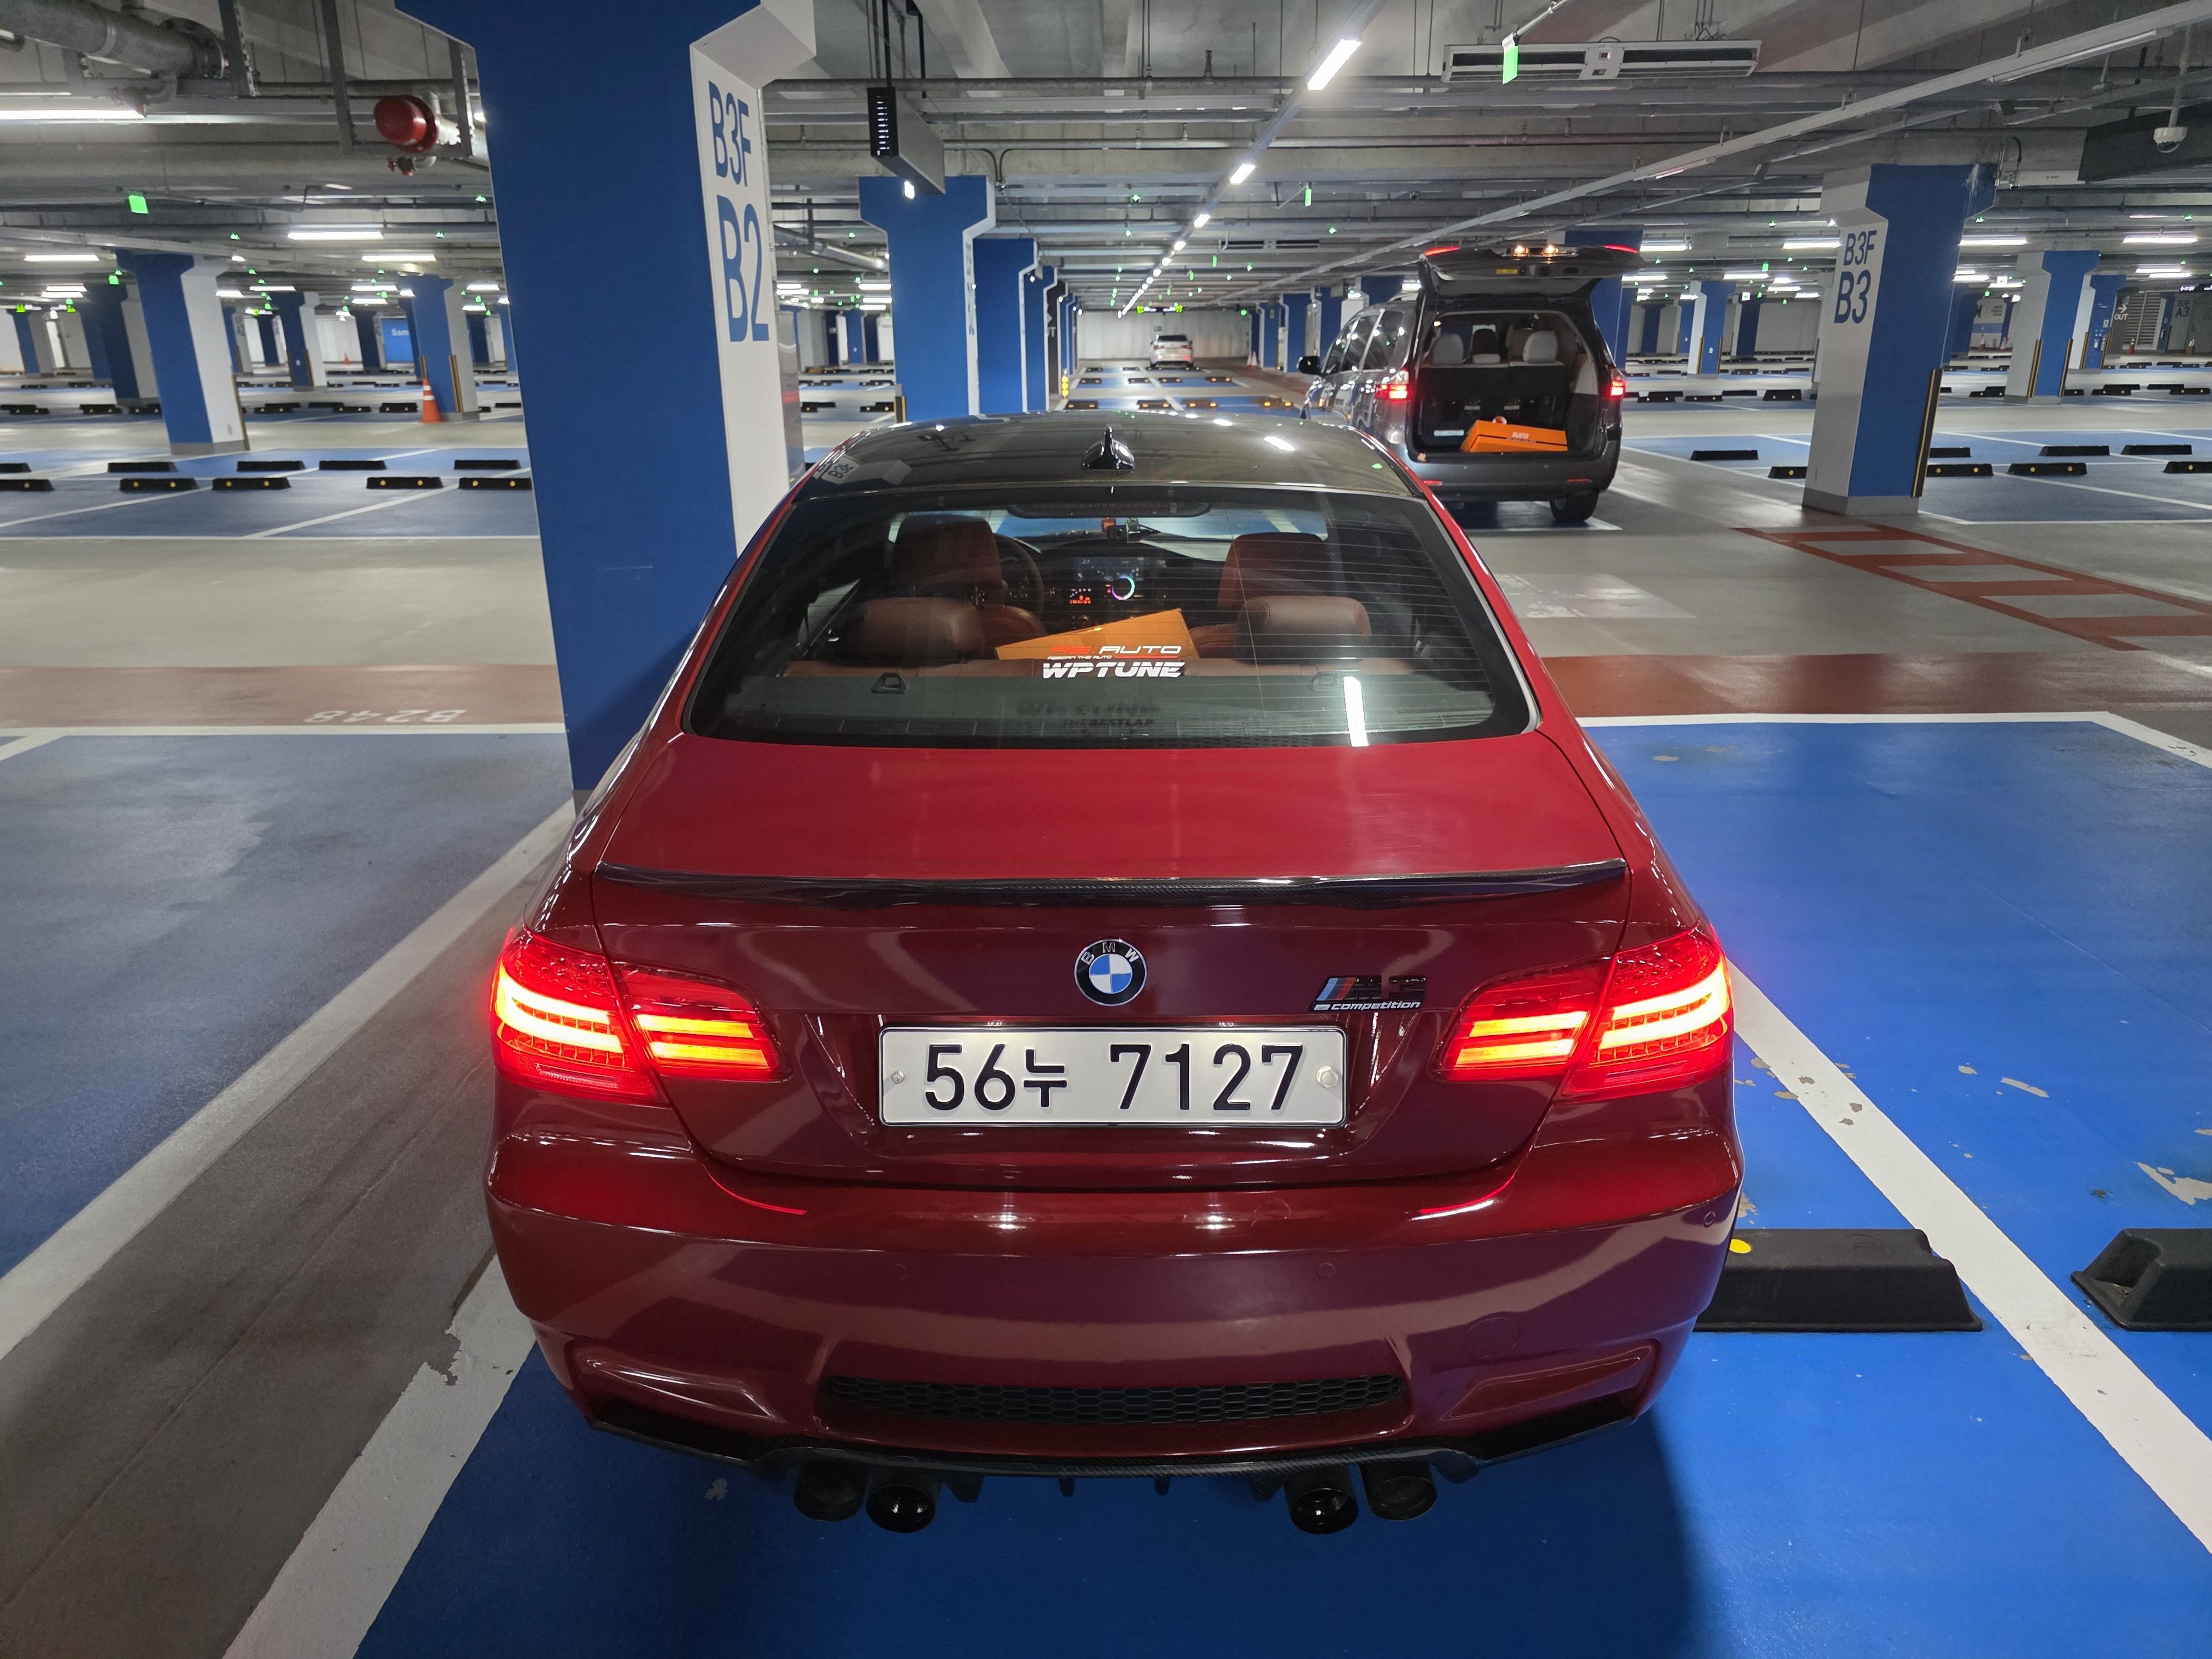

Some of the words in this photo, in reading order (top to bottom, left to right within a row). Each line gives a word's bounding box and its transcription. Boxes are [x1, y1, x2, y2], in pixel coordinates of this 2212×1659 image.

[708, 80, 751, 187] B3F
[1843, 230, 1877, 265] B3F
[717, 194, 769, 342] B2
[1834, 269, 1871, 324] B3
[2175, 306, 2190, 319] A3
[303, 709, 468, 723] B248
[1081, 941, 1140, 966] BMW
[1331, 1000, 1421, 1011] competition
[925, 1044, 1067, 1110] 56누
[1110, 1044, 1303, 1110] 7127
